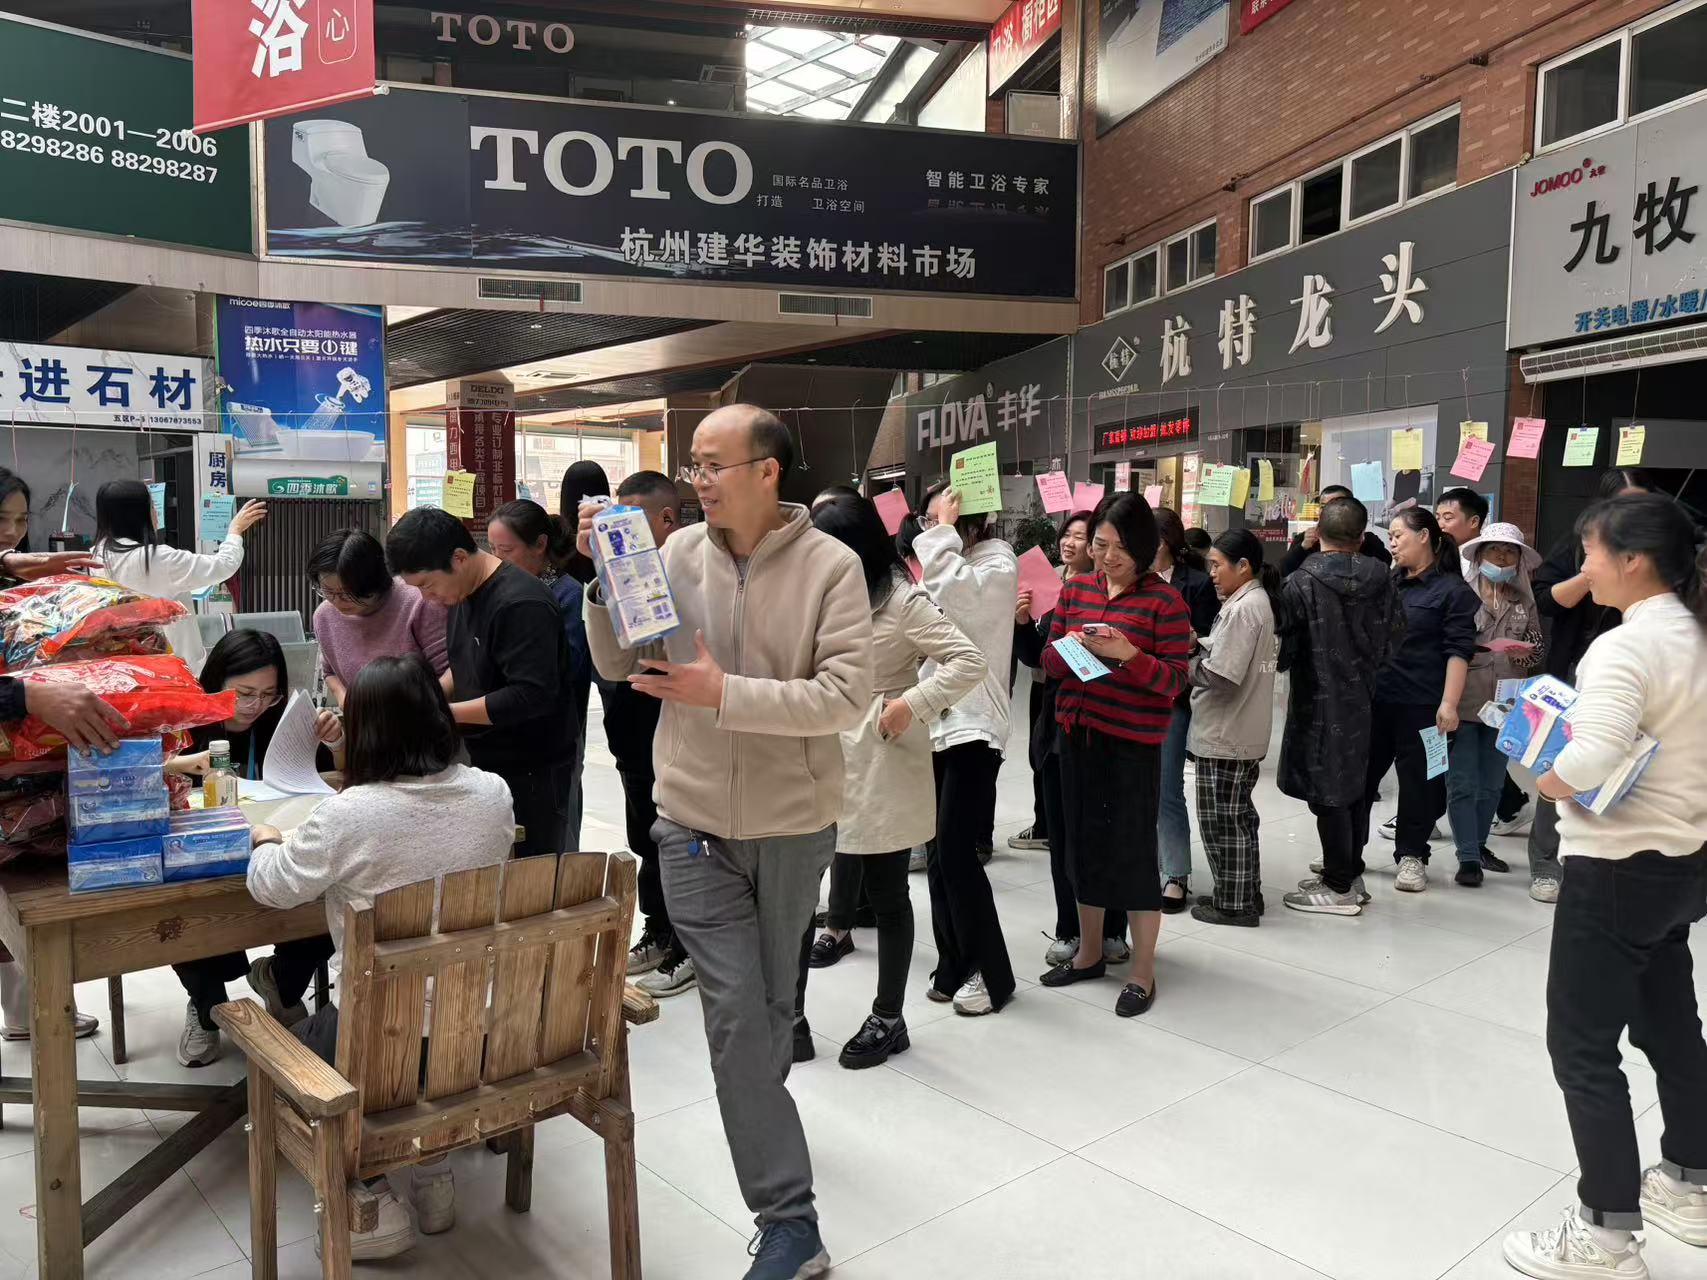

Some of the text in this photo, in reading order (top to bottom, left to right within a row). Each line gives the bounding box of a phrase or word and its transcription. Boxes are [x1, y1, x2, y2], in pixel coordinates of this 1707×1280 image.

[248, 0, 309, 78] 浴
[325, 8, 350, 41] 心
[431, 11, 575, 54] TOTO
[111, 150, 218, 184] 88298287
[470, 125, 754, 206] TOTO
[772, 174, 849, 192] 国际名品卫浴
[926, 169, 1049, 195] 智能卫浴专家
[1530, 167, 1584, 197] JOMOO
[757, 193, 865, 214] 打造 卫浴空间
[1563, 176, 1699, 273] 九牧
[620, 226, 977, 279] 杭州建华装饰材料市场
[244, 325, 357, 339] 四季沐歌全自动太阳能热水器
[1160, 241, 1430, 385] 杭特龙头
[0, 357, 196, 411] 进石材
[917, 383, 1040, 451] FLOVA 丰华
[286, 483, 338, 495] 四季沐歌
